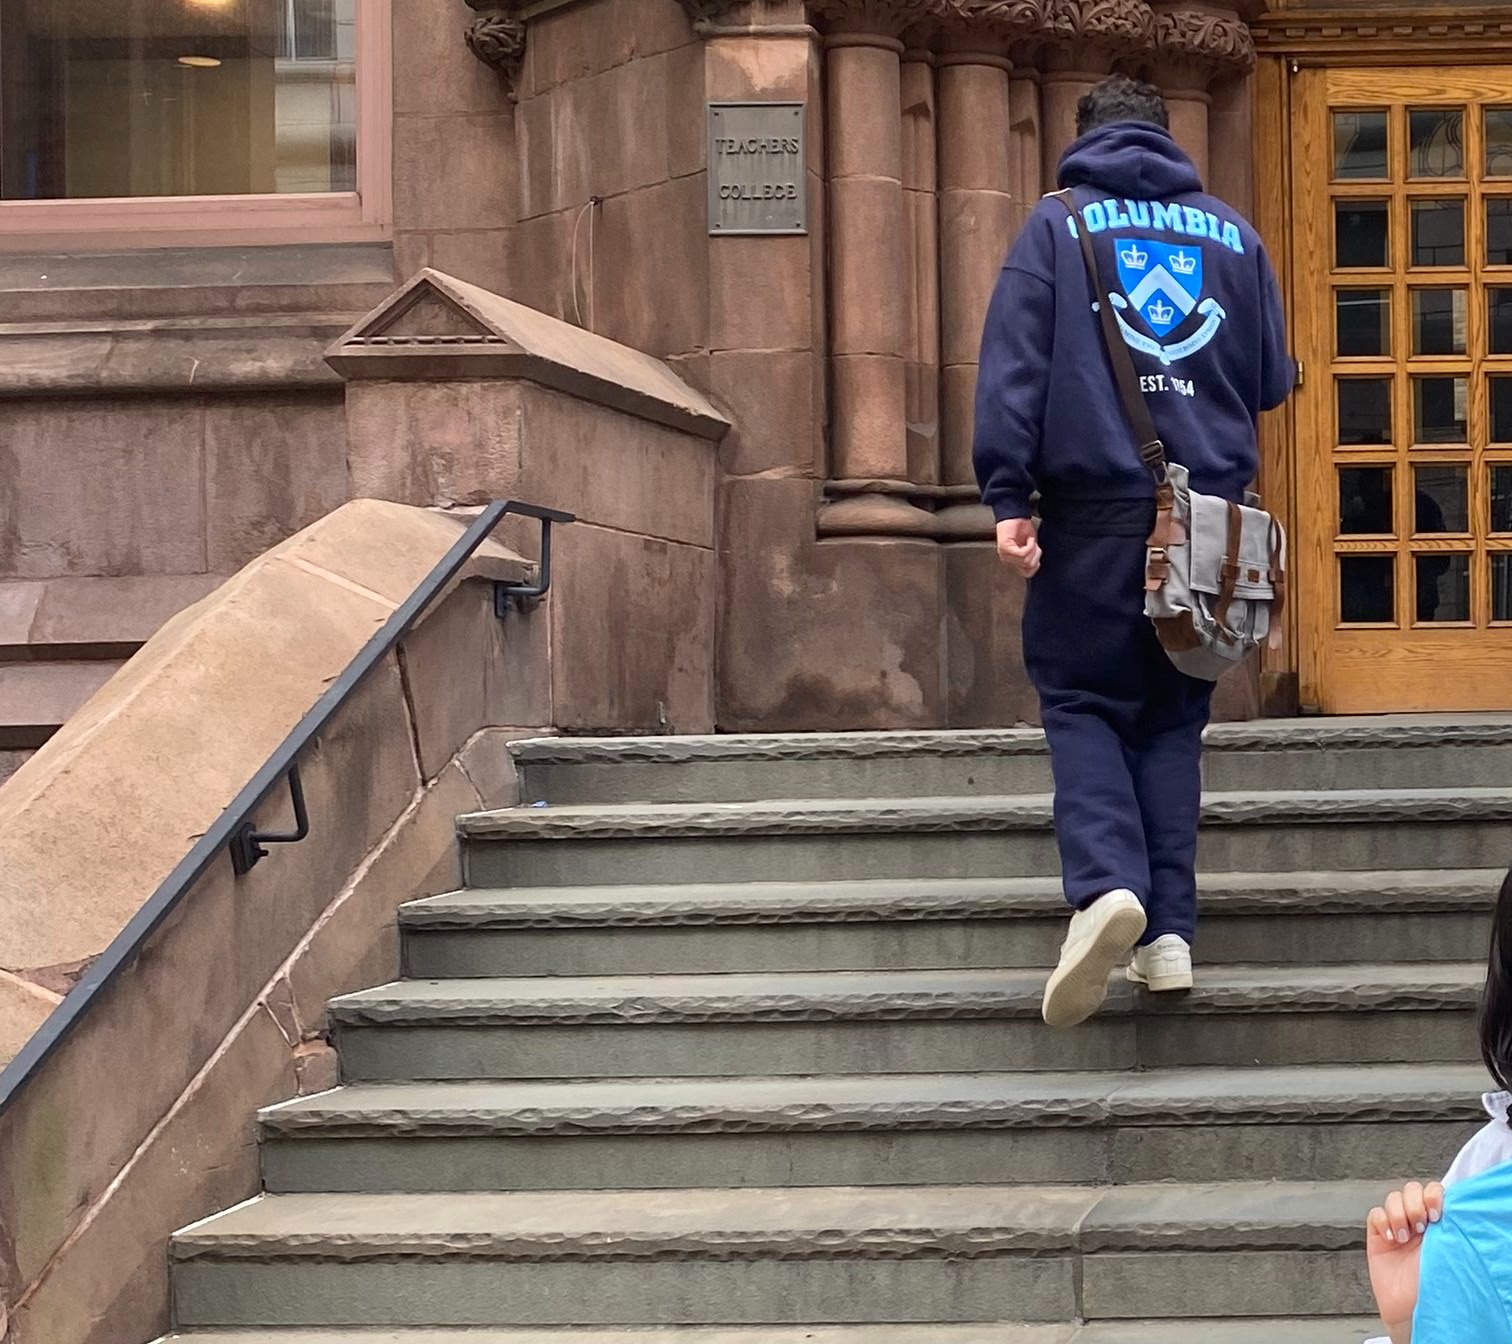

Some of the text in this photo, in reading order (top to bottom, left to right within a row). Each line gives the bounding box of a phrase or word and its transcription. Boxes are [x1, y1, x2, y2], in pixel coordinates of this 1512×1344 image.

[714, 136, 800, 155] TEACHERS
[719, 182, 798, 201] COLLEGE
[1139, 374, 1169, 392] EST.
